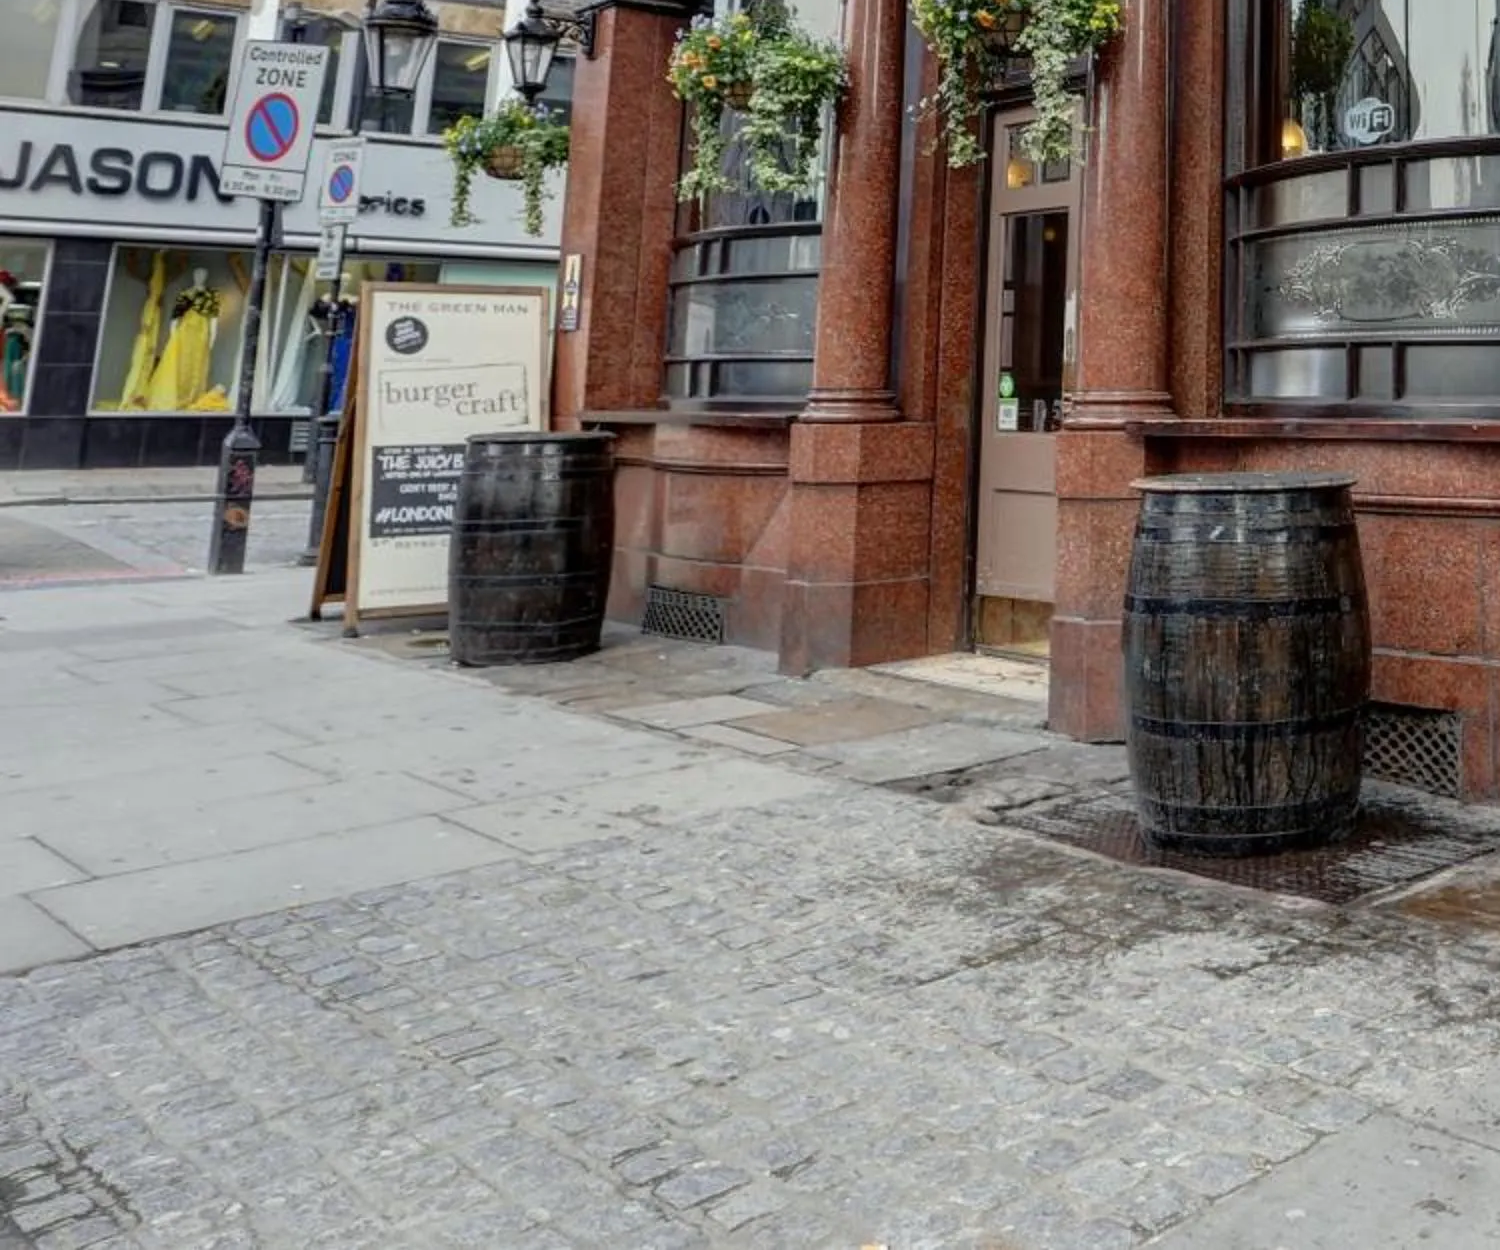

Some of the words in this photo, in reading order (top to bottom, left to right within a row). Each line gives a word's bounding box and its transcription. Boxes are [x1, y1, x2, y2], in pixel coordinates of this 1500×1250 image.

[250, 46, 323, 66] Controlled
[255, 66, 308, 88] ZONE
[0, 140, 236, 206] JASON
[387, 301, 423, 314] THE
[428, 302, 487, 314] GREEN
[493, 303, 529, 315] MAN
[385, 381, 477, 407] burger
[455, 387, 520, 417] craft
[376, 454, 411, 471] THE
